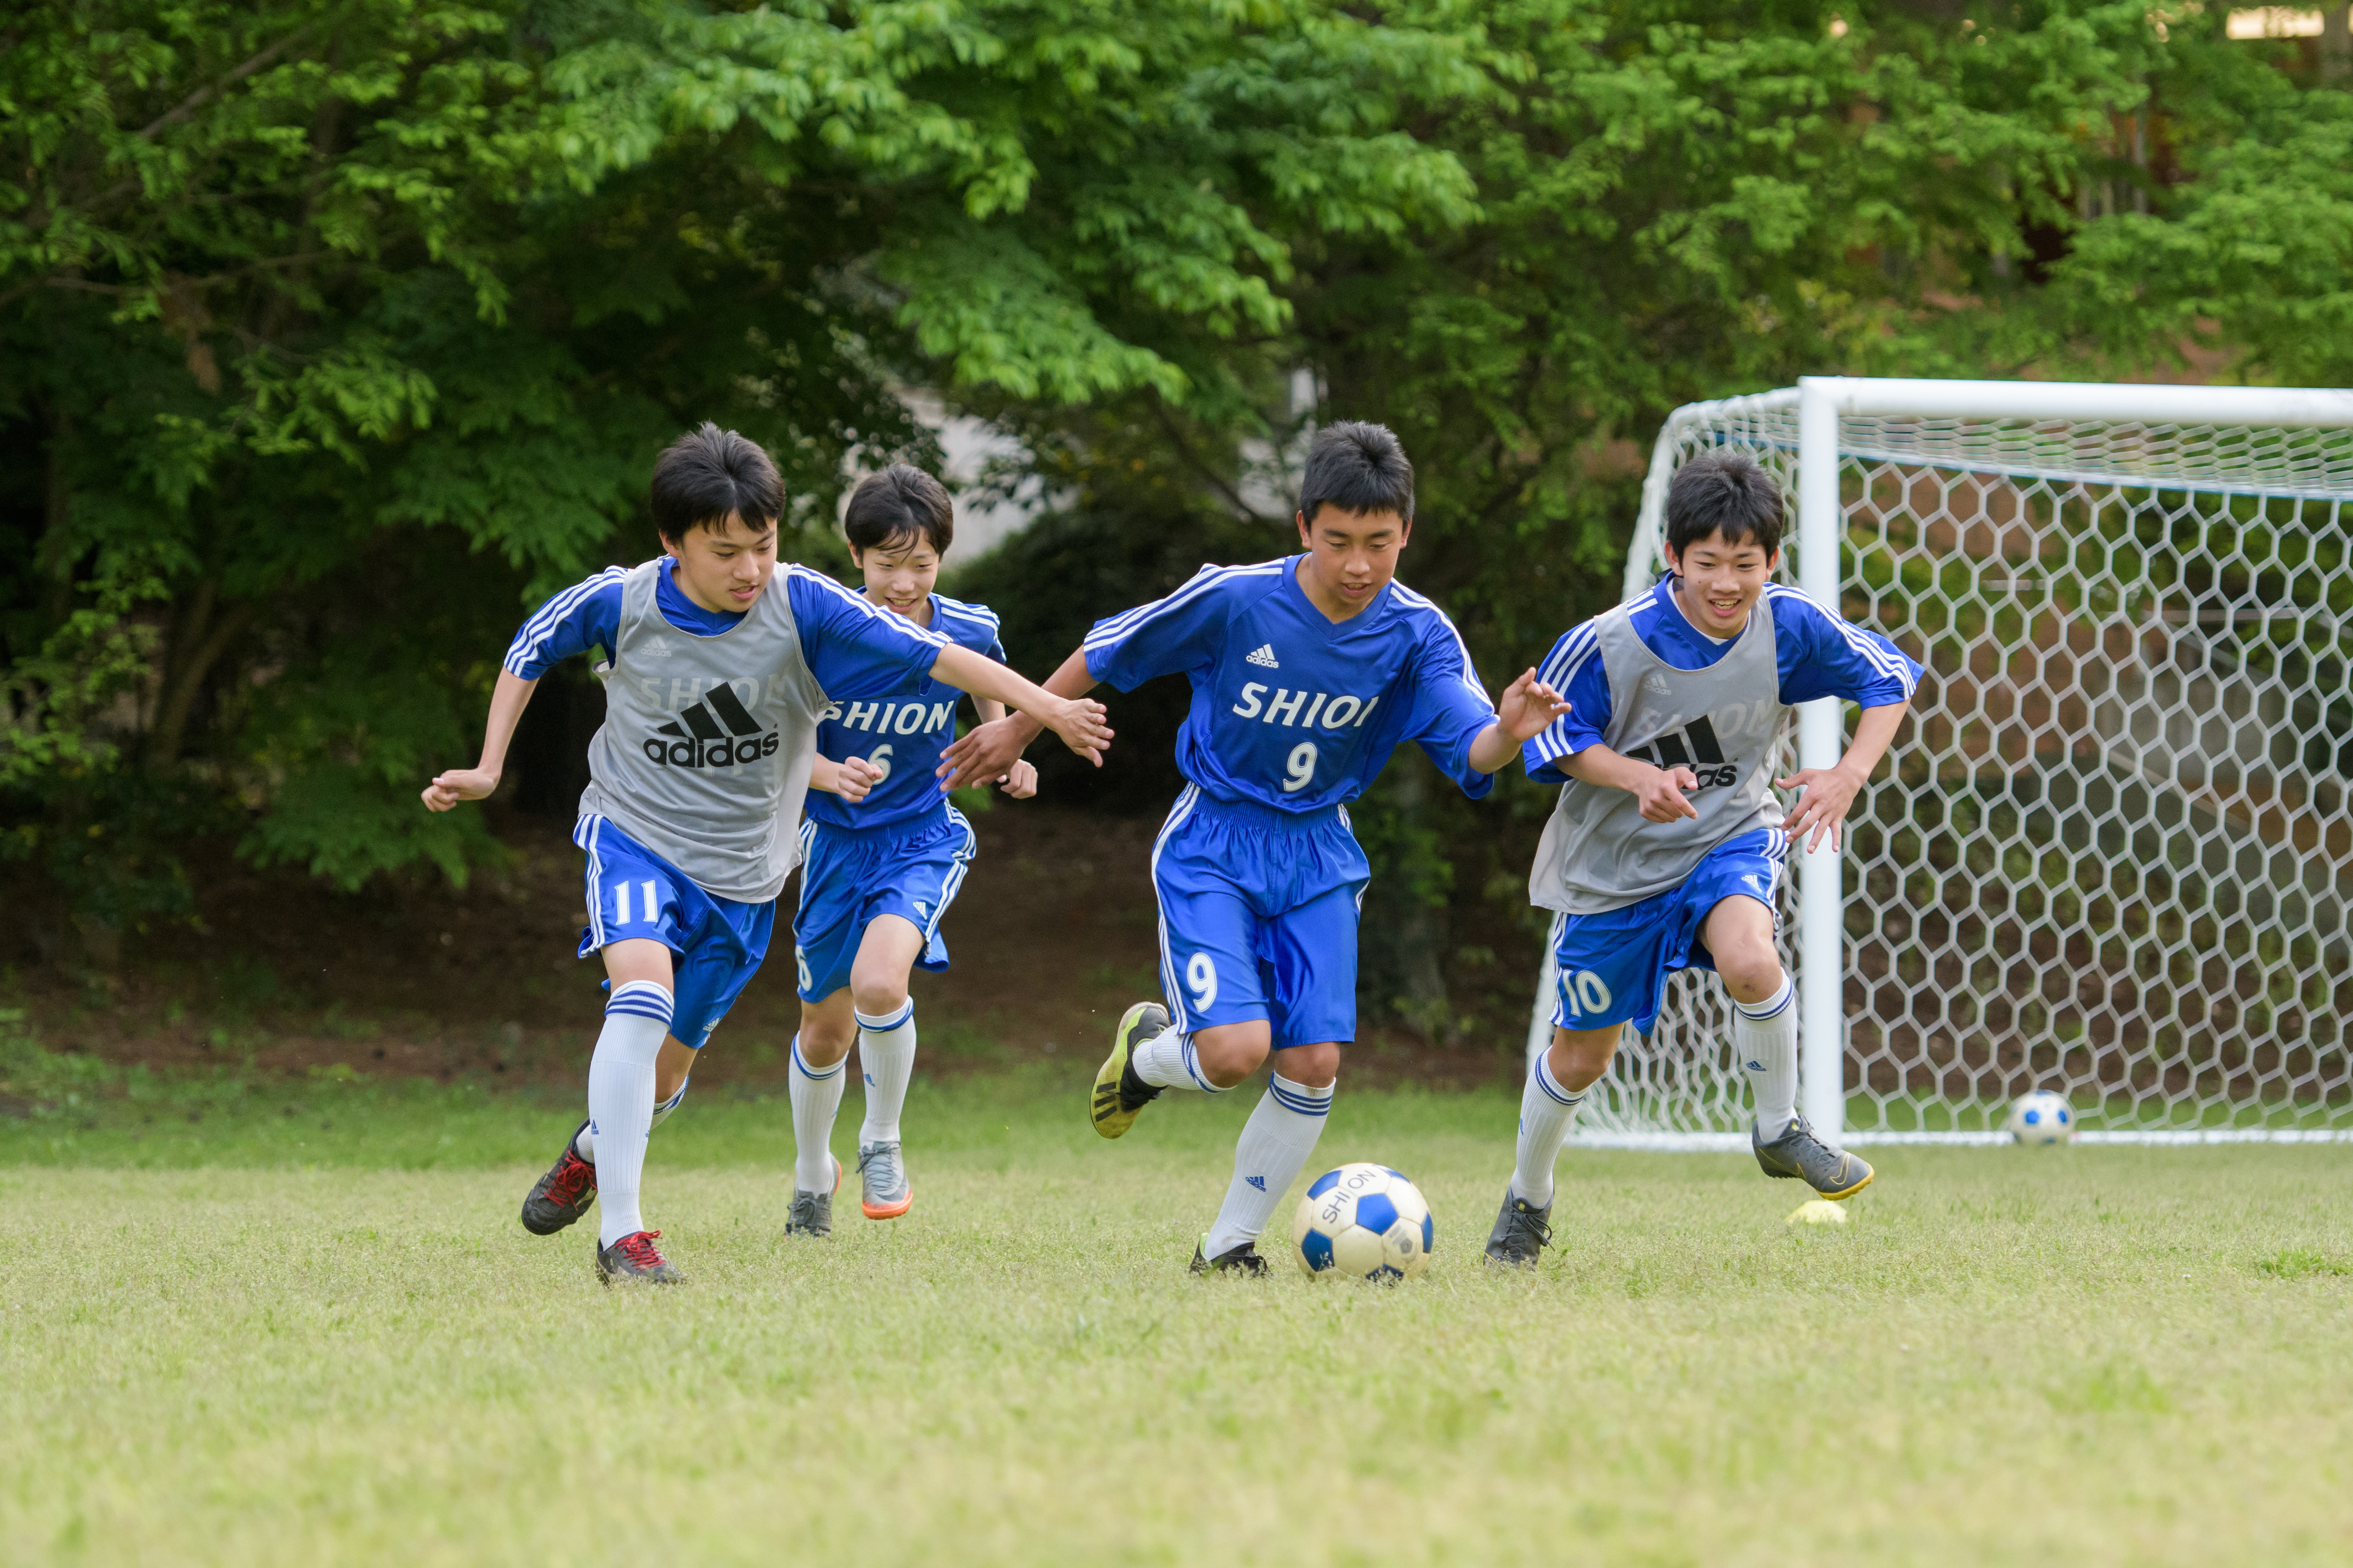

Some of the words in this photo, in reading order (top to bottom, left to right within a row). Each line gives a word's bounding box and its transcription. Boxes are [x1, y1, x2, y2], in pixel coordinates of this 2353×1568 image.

[640, 647, 672, 657] adidas
[1246, 654, 1279, 668] adidas
[643, 732, 779, 768] adidas
[867, 743, 893, 785] 6
[1283, 742, 1317, 792] 9
[614, 880, 658, 925] 11
[1187, 952, 1217, 1013] 9
[1562, 969, 1612, 1017] 10
[1245, 1177, 1267, 1192] adidas
